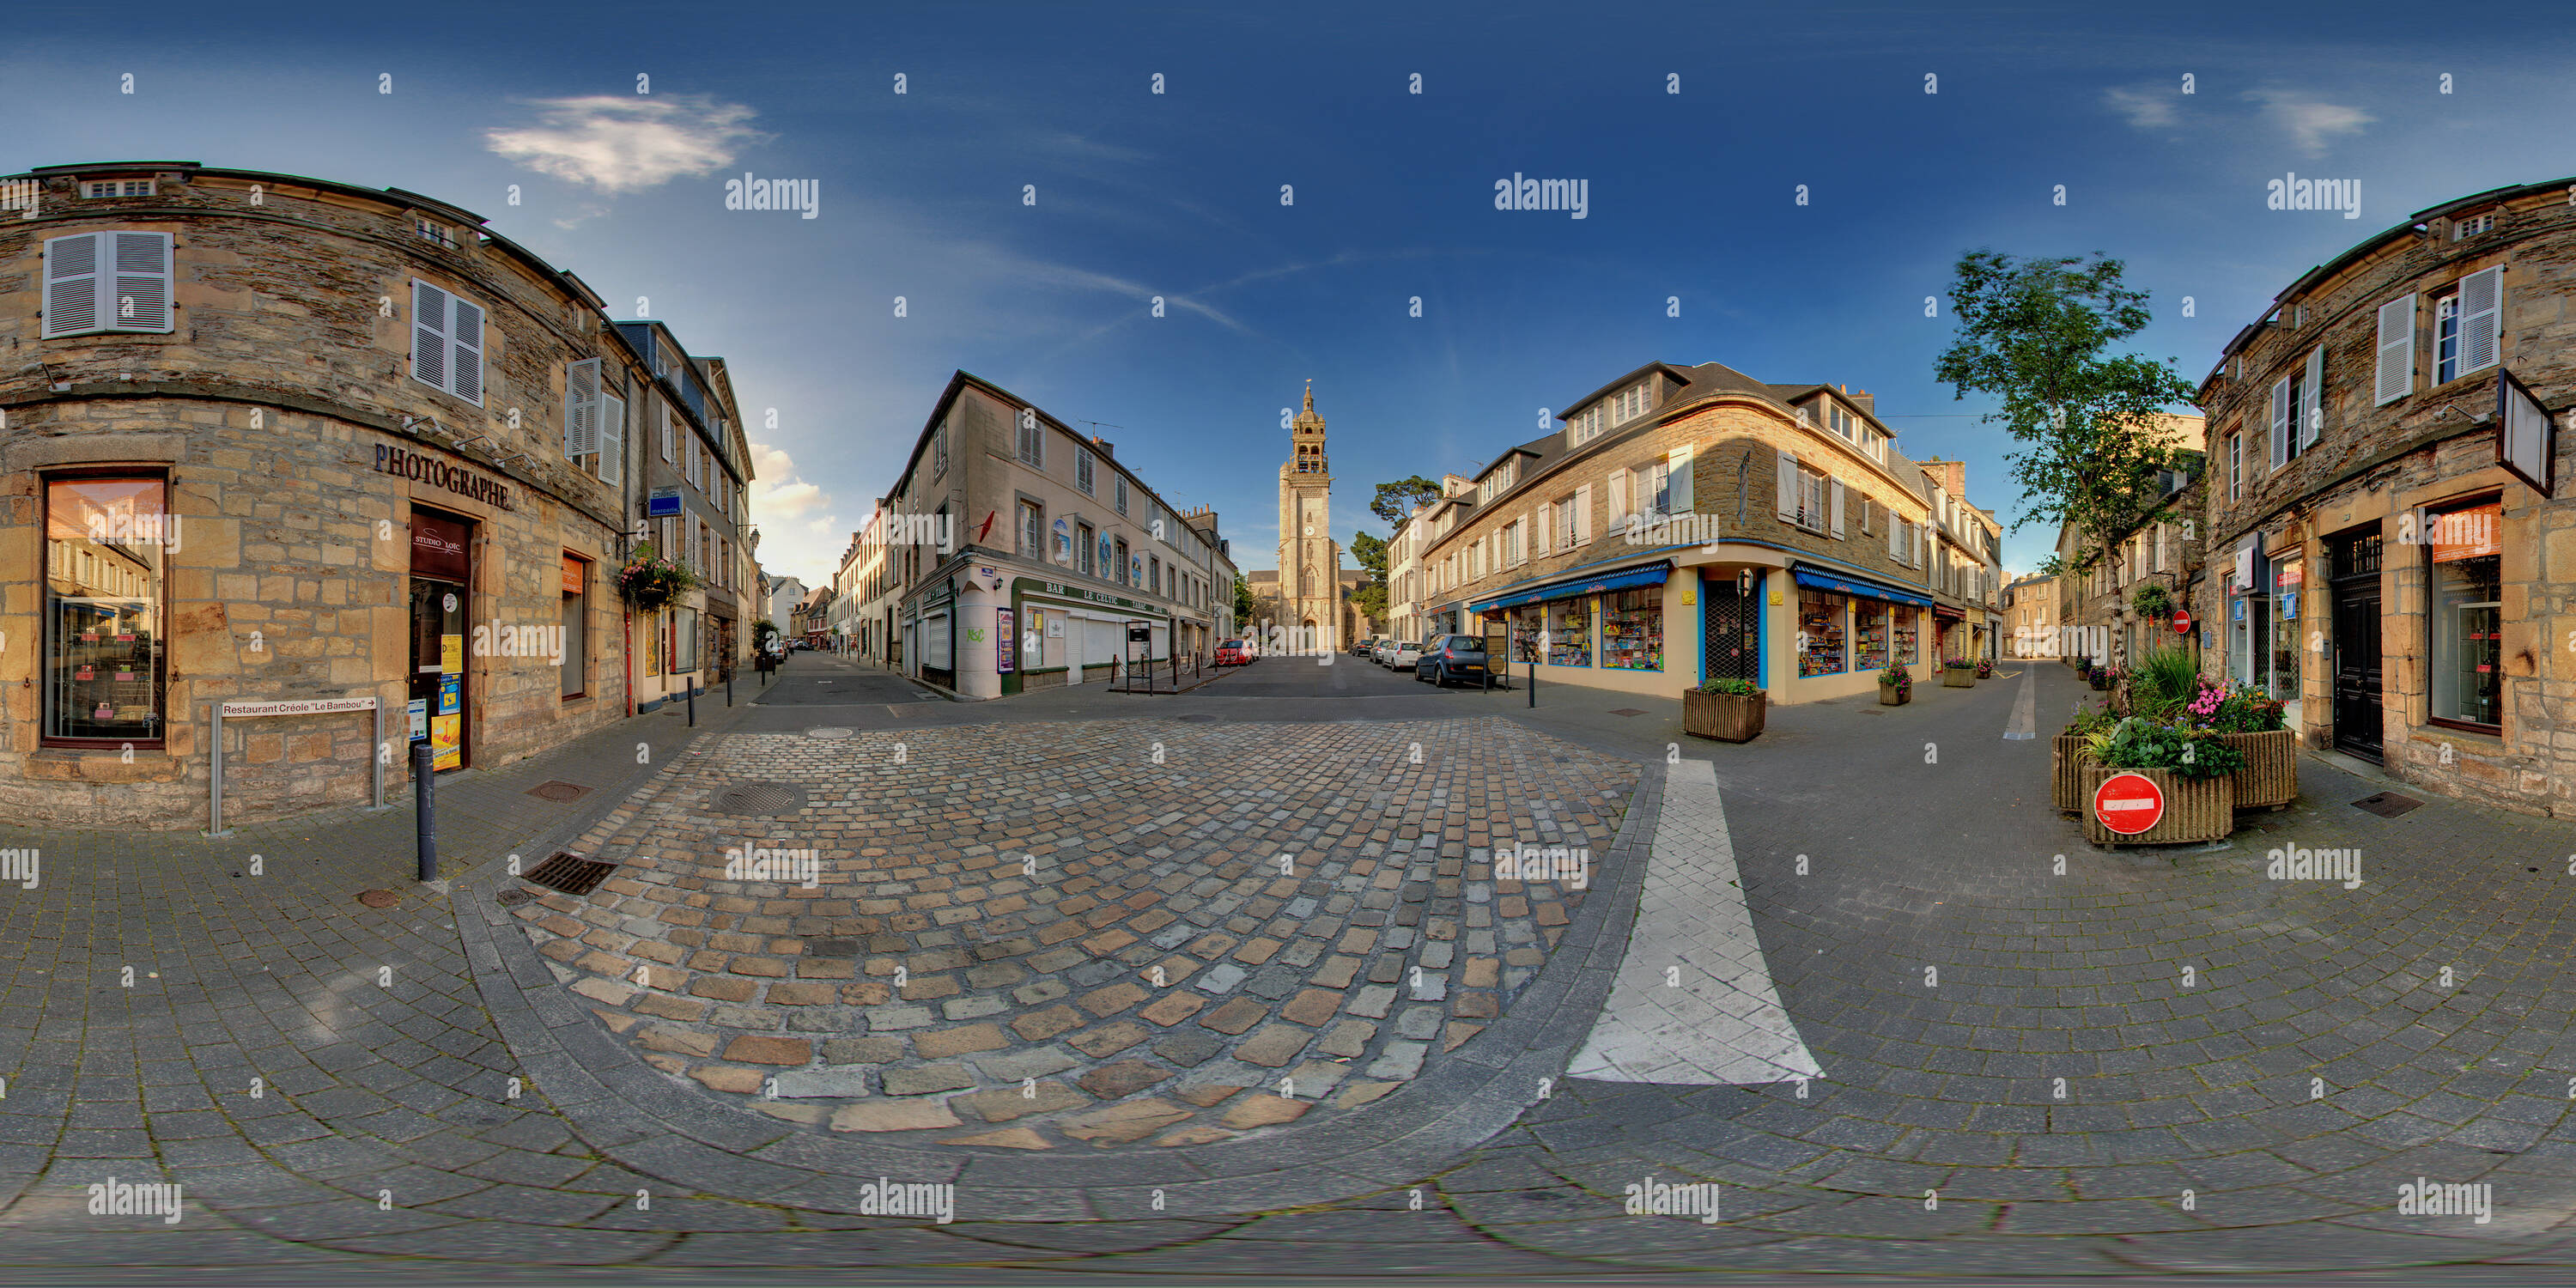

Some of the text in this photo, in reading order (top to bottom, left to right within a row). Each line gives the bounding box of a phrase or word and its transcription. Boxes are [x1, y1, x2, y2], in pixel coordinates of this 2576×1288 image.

[375, 443, 513, 511] PHOTOGRAPHE
[416, 536, 461, 550] STUDIO LOÏC
[1046, 582, 1065, 595] BAR
[1084, 590, 1093, 600] LE
[1096, 592, 1118, 605] CELTIC
[223, 700, 365, 714] Restaurant Créole "Le Bambou"
